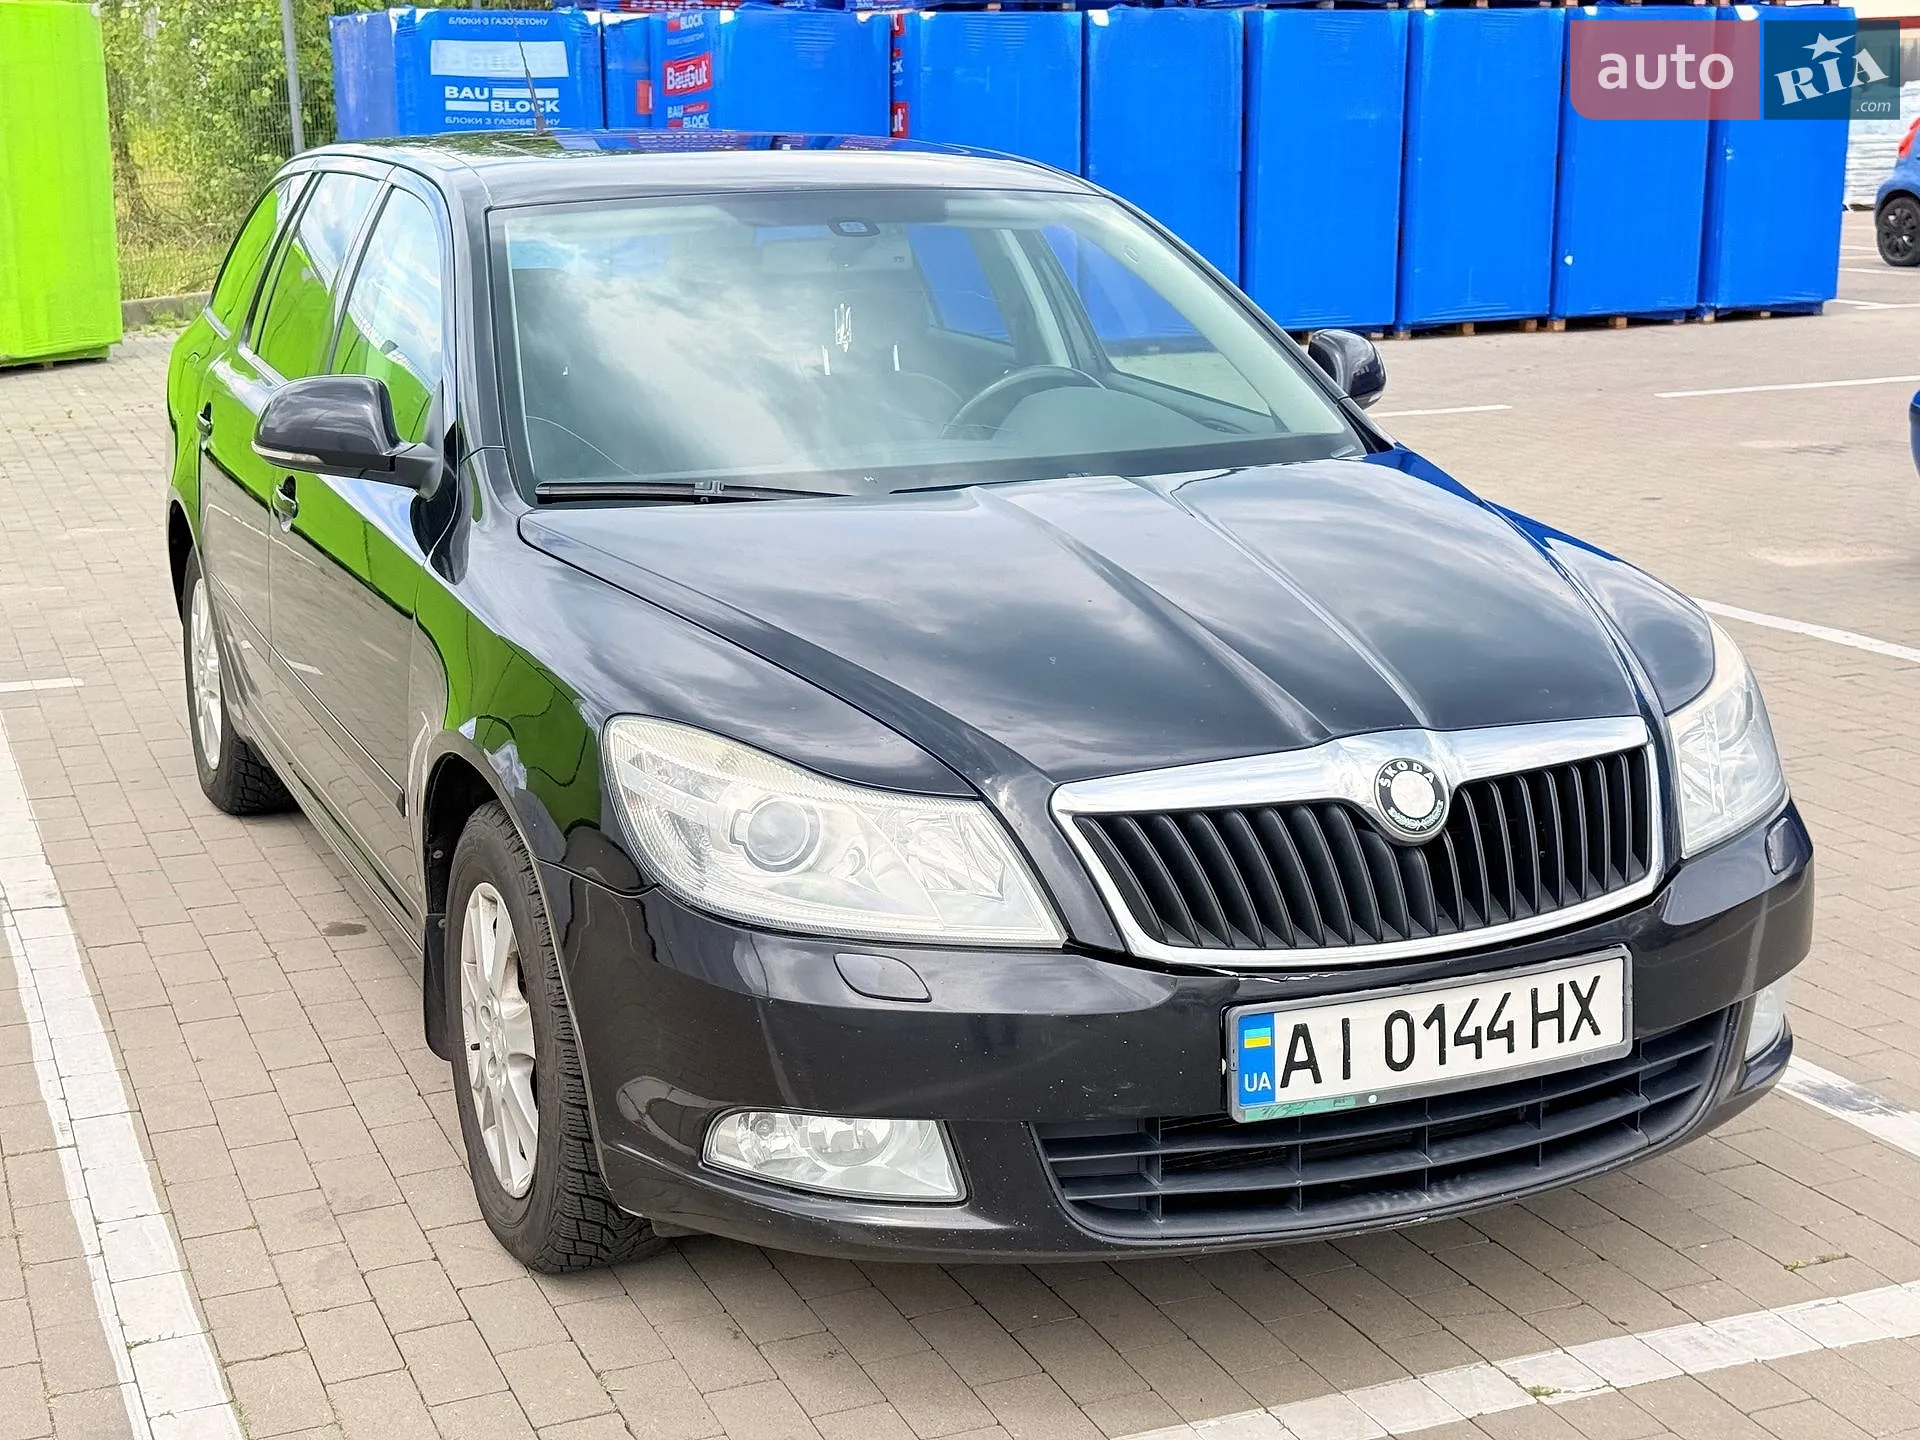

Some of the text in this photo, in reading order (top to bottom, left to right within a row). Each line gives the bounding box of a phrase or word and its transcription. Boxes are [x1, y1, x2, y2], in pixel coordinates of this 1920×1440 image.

[448, 16, 481, 25] БЛОКИ
[666, 60, 708, 90] BauGut
[444, 85, 489, 99] BAU
[490, 100, 560, 113] BLOCK
[667, 105, 684, 118] BAU
[445, 116, 482, 125] БЛОКИ
[493, 117, 560, 126] ГАЗОБЕТНУ
[683, 113, 709, 129] BLOCK
[1280, 975, 1602, 1089] AI 0144 HX
[1244, 1071, 1272, 1092] UA
